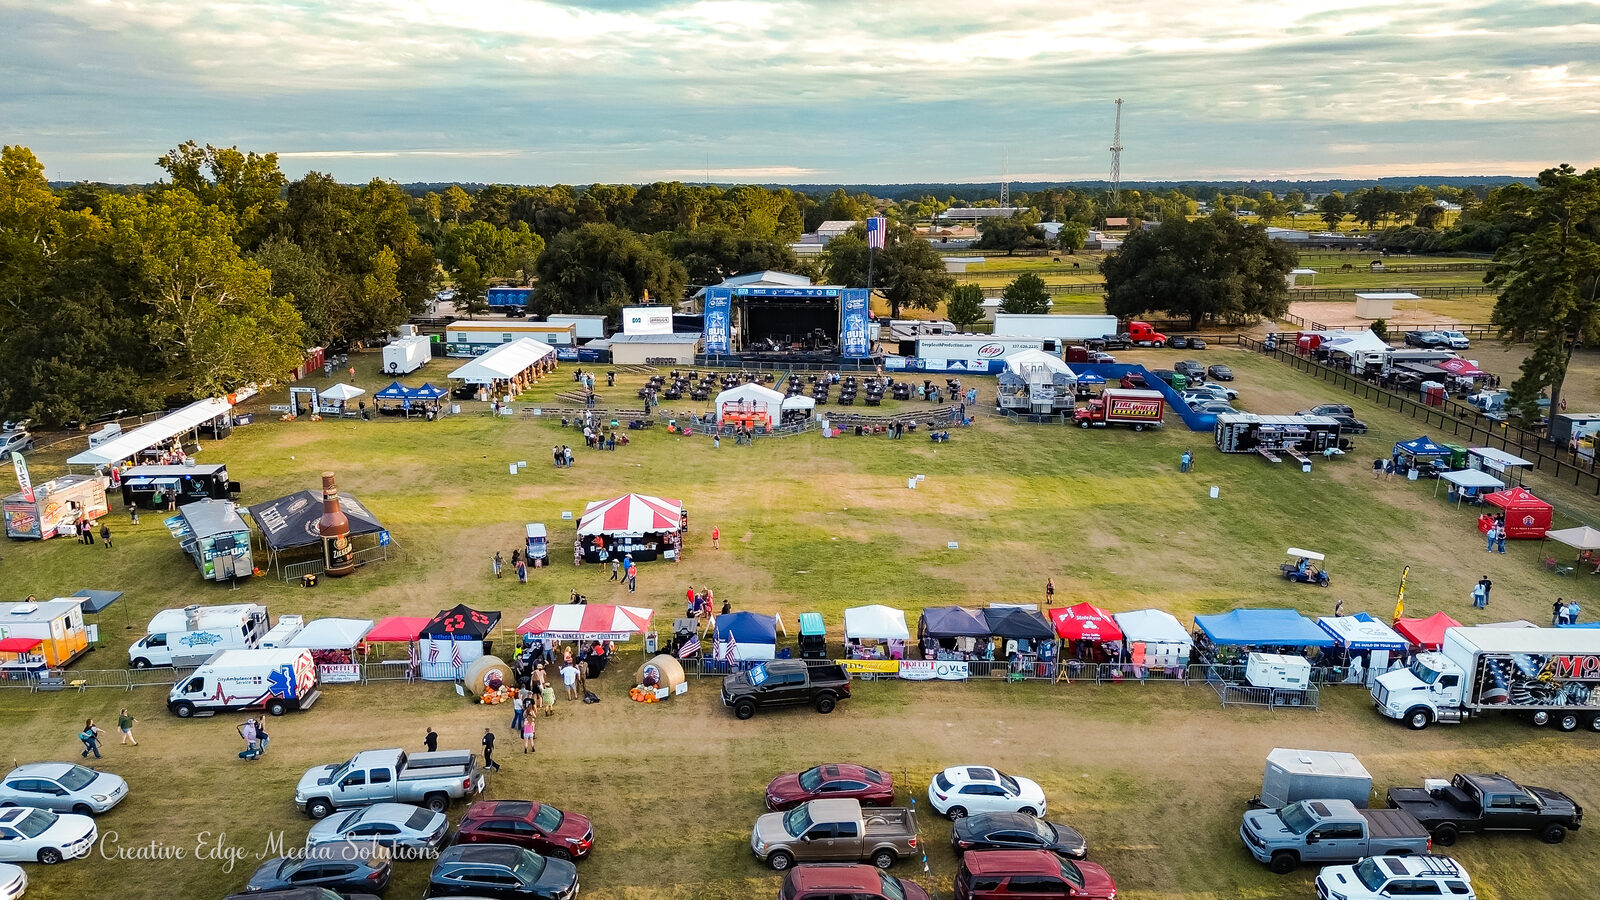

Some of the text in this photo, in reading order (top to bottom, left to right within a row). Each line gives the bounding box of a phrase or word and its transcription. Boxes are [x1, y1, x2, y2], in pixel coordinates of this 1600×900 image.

[708, 328, 725, 336] BUD
[845, 338, 867, 346] LIGHT
[981, 344, 1001, 358] dsp
